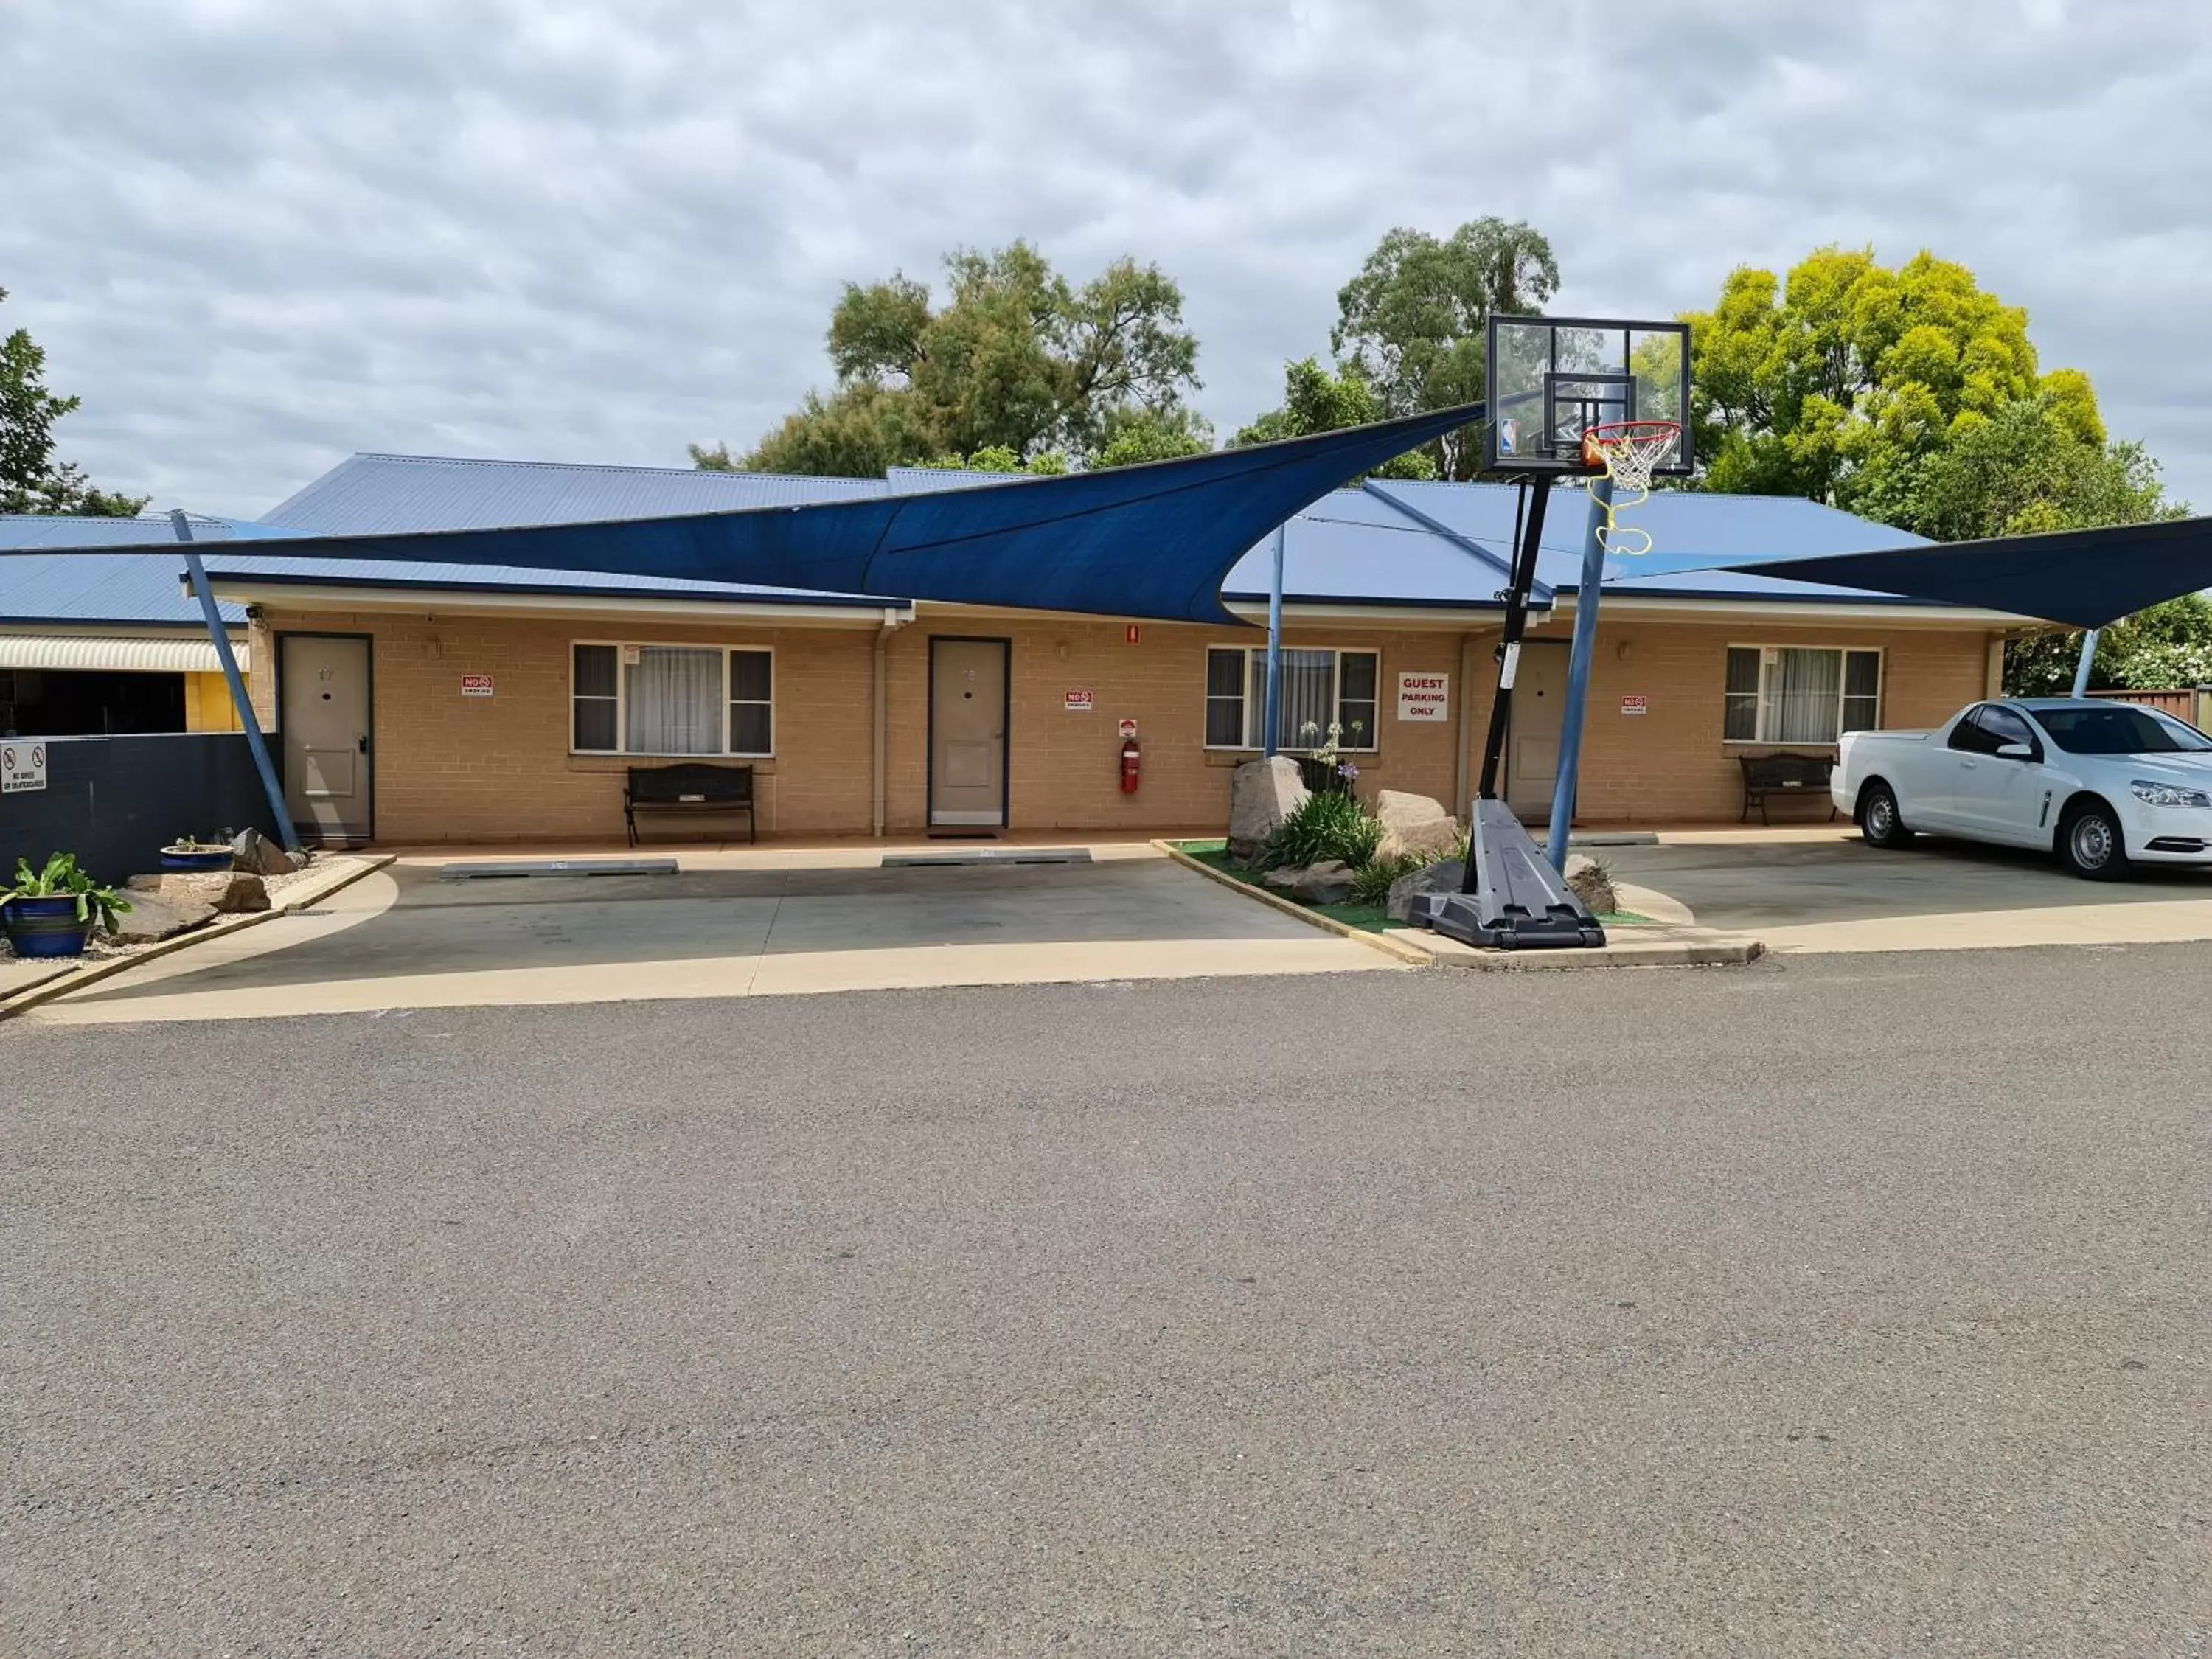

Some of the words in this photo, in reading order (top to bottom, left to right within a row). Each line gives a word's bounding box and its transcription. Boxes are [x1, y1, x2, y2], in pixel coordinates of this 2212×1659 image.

[1403, 678, 1444, 689] GUEST
[1402, 693, 1444, 702] PARKING
[1410, 707, 1435, 715] ONLY
